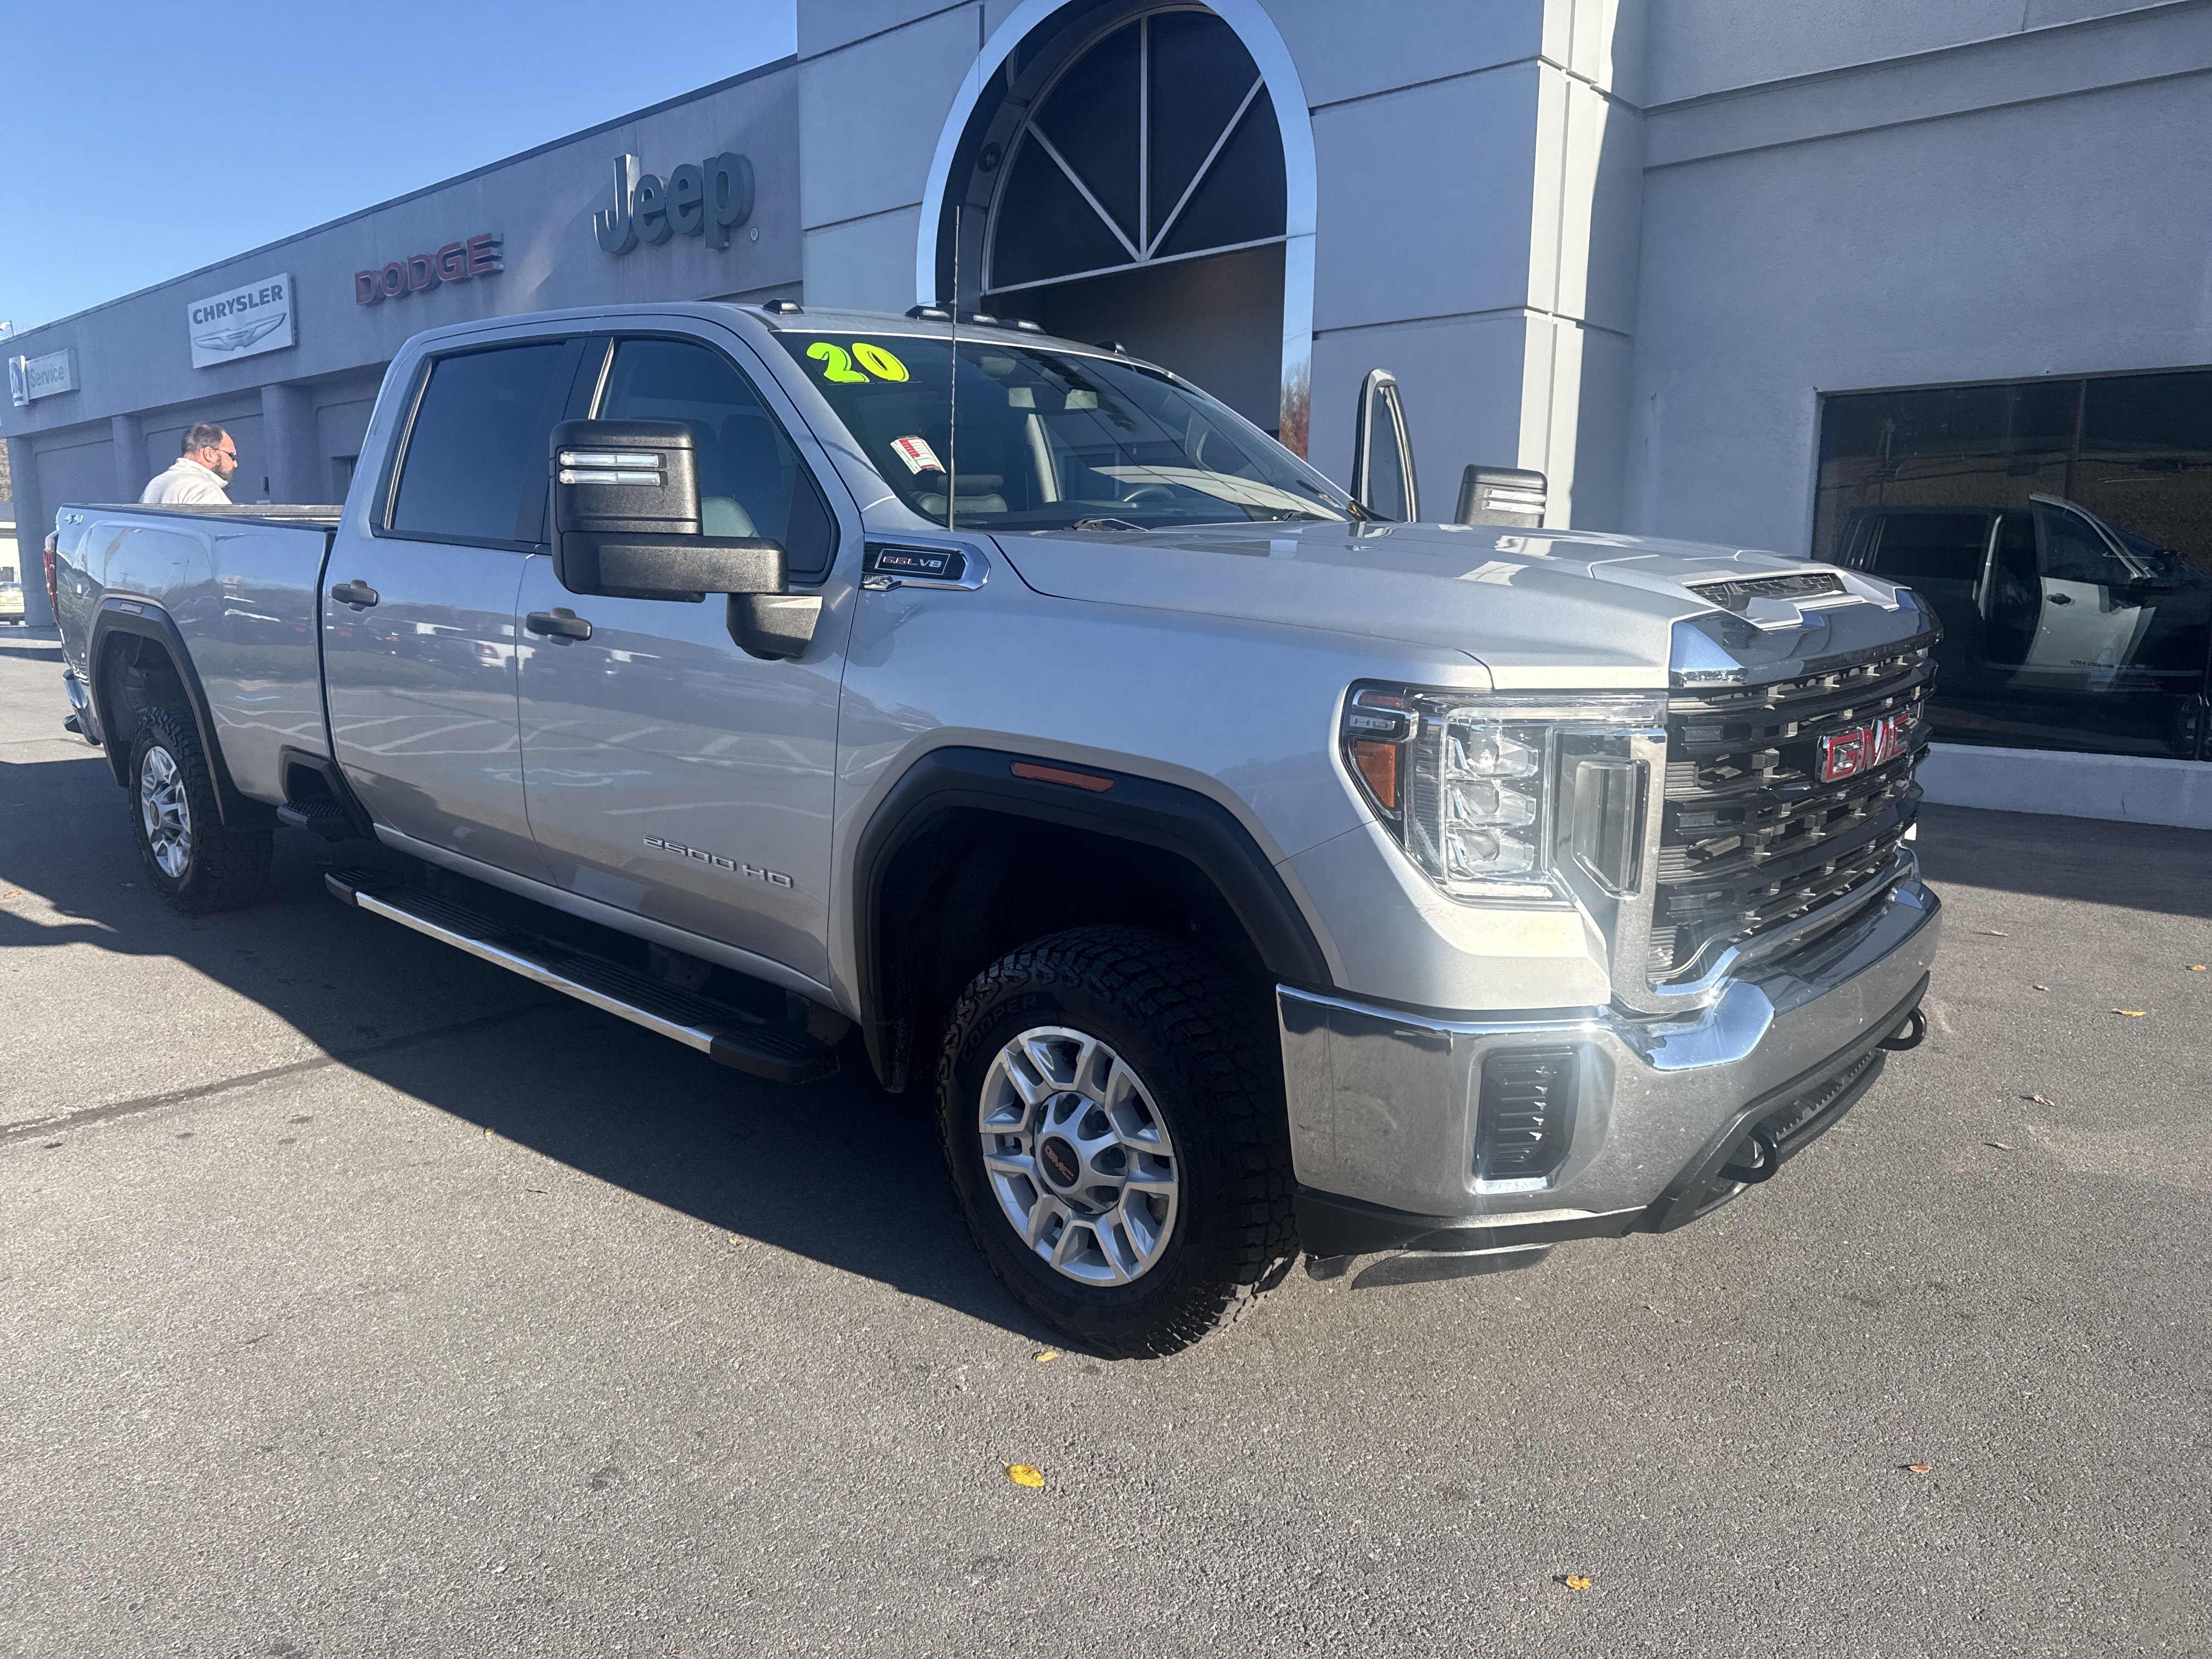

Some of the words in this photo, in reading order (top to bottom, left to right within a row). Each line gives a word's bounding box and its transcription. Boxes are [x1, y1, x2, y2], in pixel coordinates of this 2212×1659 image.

[593, 151, 755, 255] Jeep
[354, 232, 504, 306] DODGE
[193, 284, 283, 324] CHRYSLER
[30, 364, 64, 388] Service
[806, 342, 910, 383] 20
[1820, 713, 1915, 783] GMC
[642, 833, 737, 871] 2500
[742, 862, 793, 888] HD
[961, 995, 1037, 1063] COOPER
[1045, 1145, 1074, 1181] GMC
